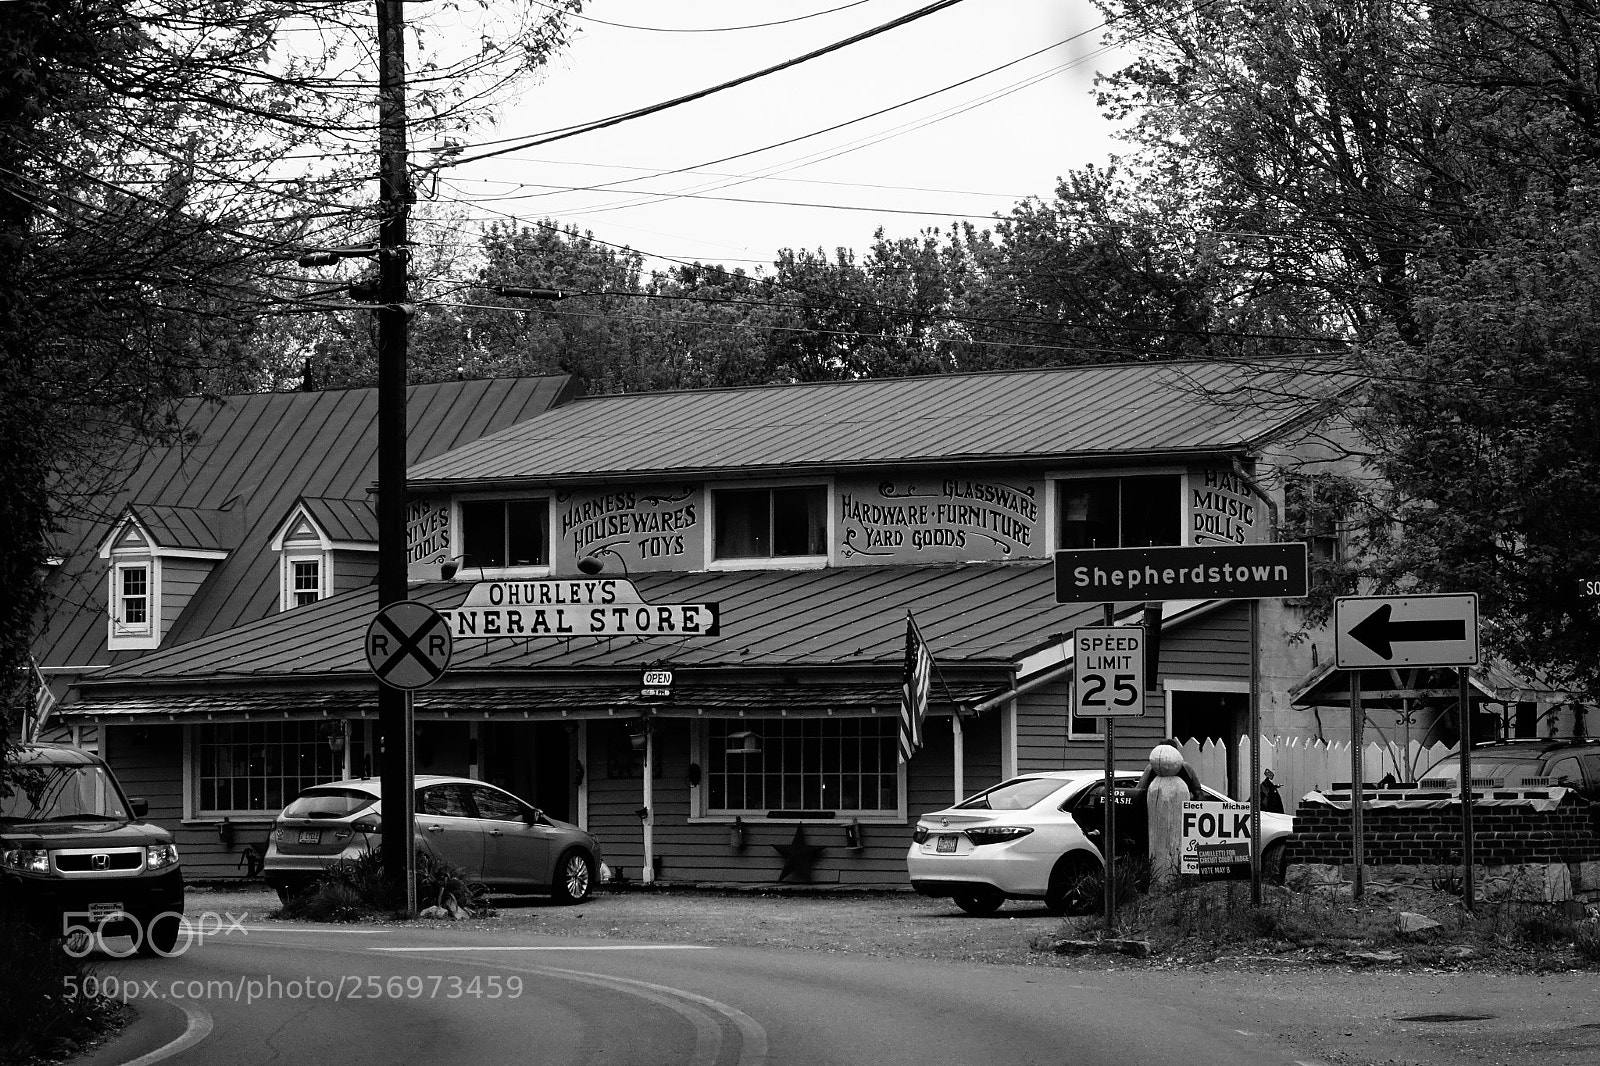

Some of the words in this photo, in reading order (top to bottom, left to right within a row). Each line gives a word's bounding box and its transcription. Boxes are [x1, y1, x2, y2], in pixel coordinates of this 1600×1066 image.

[406, 497, 430, 523] INS
[942, 479, 1038, 523] GLASSWARE
[1193, 489, 1253, 527] MUSIC
[406, 507, 449, 544] NIVES
[562, 491, 636, 540] HARNESS
[841, 493, 928, 530] HARDWARE
[937, 504, 1032, 547] FURNITURE
[574, 503, 697, 558] HOUSEWARES
[864, 527, 903, 550] YARD
[912, 528, 967, 551] GOODS
[1194, 514, 1245, 544] DOLLS
[406, 530, 450, 564] TOOLS
[638, 535, 685, 559] TOYS
[1073, 563, 1289, 589] Shepherdstown
[489, 580, 616, 606] O'HURLEY'S
[446, 608, 573, 635] NERAL
[590, 605, 700, 632] STORE
[371, 634, 389, 656] R
[429, 634, 446, 656] R
[1080, 637, 1139, 651] SPEED
[1086, 655, 1132, 670] LIMIT
[646, 673, 671, 683] OPEN
[1081, 673, 1138, 707] 25
[1222, 802, 1250, 810] Michae
[1183, 812, 1251, 838] FOLK
[1200, 866, 1214, 875] VOTE
[1214, 866, 1226, 874] MAY
